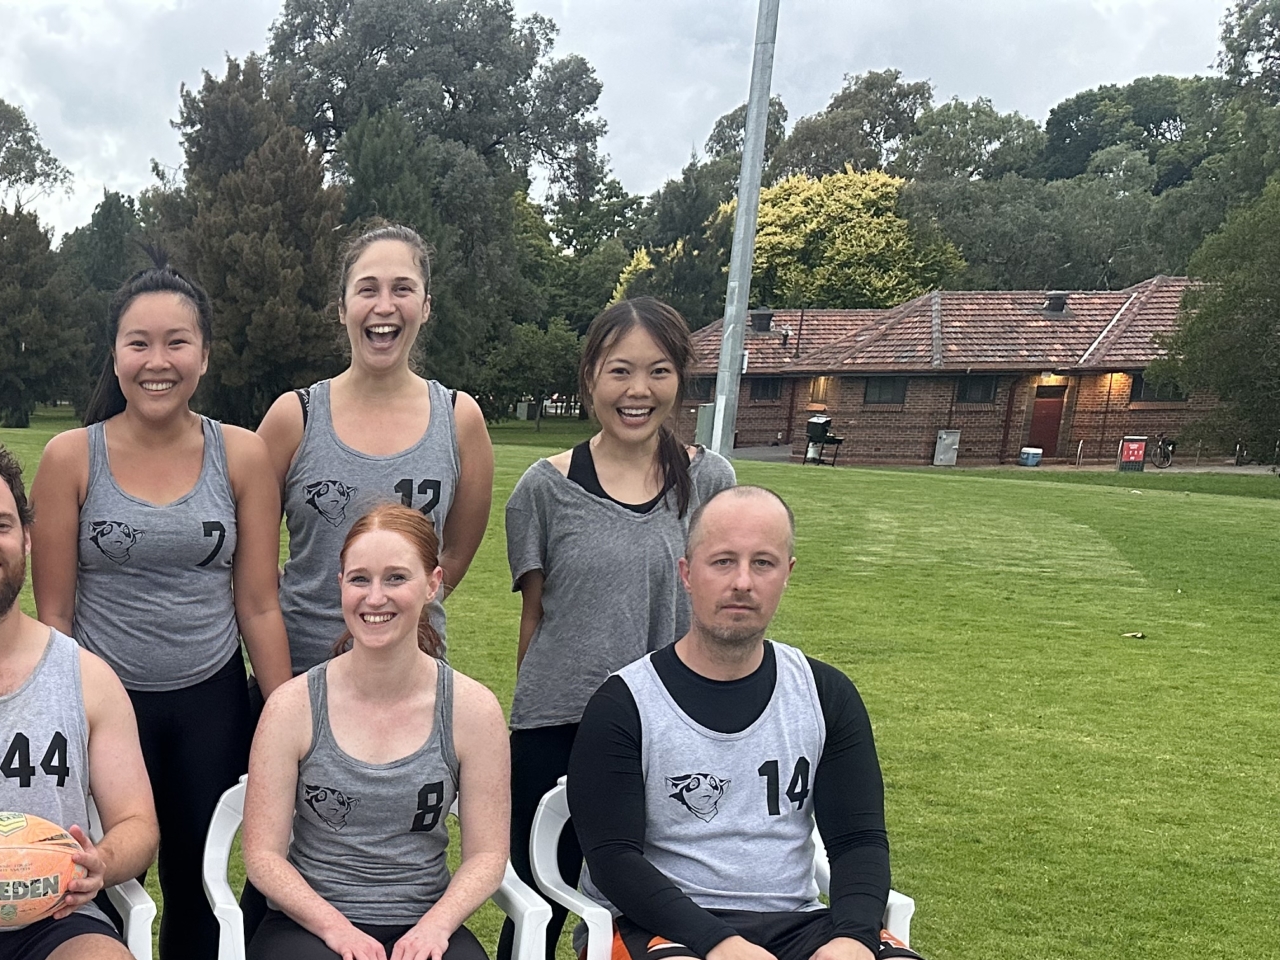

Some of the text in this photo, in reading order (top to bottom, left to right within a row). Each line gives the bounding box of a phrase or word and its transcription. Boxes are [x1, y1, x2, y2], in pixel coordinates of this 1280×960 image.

[189, 520, 226, 567] 7
[0, 731, 70, 788] 44
[757, 756, 811, 816] 14
[409, 780, 444, 832] 8
